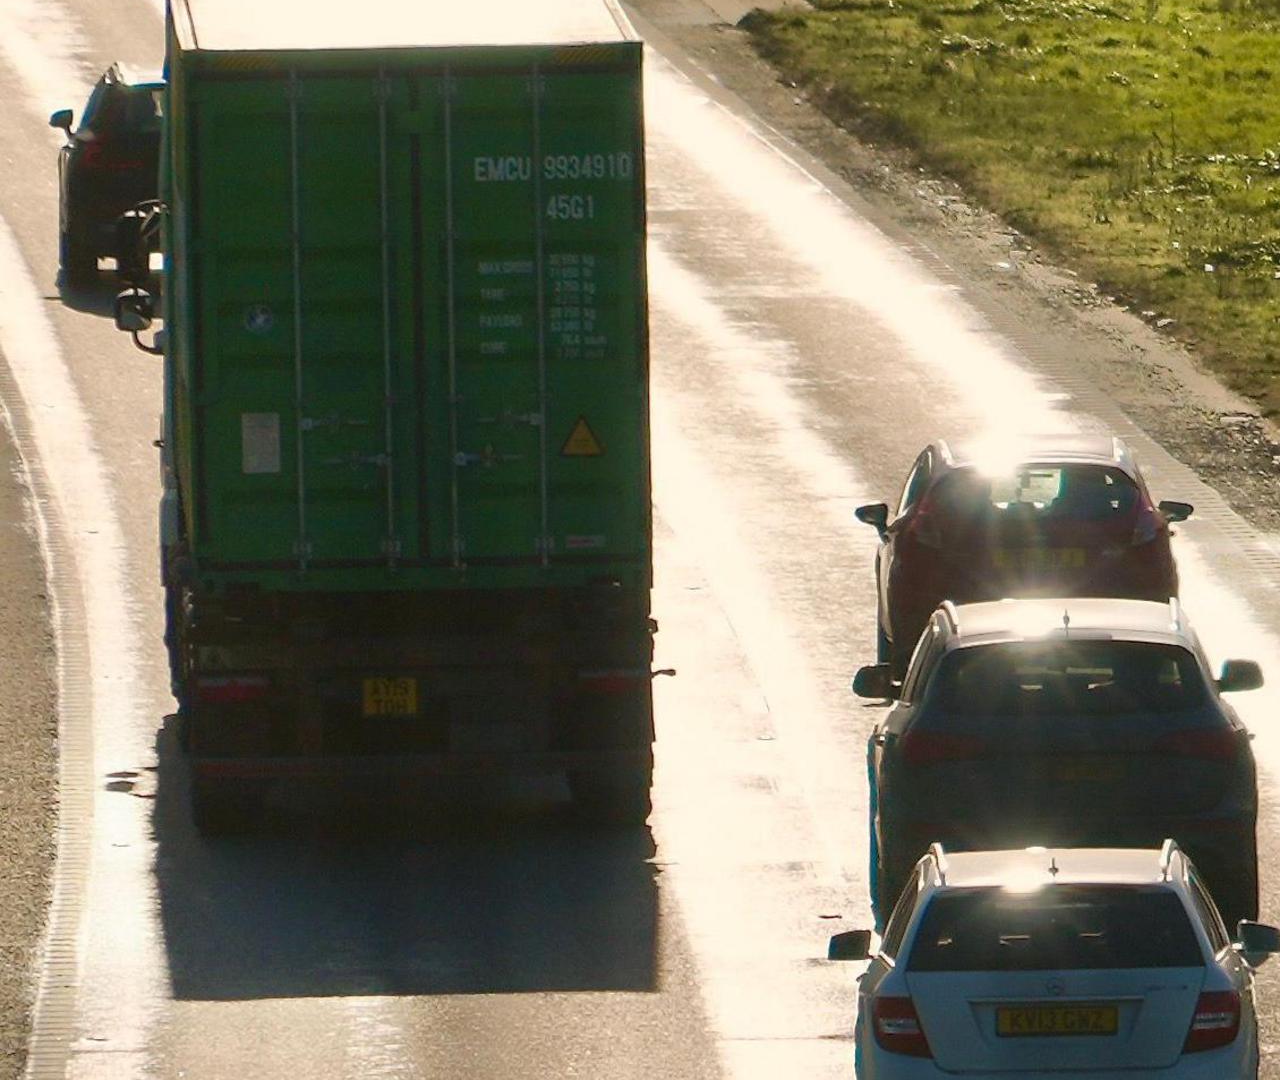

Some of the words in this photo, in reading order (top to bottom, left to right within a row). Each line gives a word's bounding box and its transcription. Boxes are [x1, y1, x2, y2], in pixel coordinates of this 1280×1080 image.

[474, 156, 531, 182] EMCU
[543, 152, 632, 181] 9934910
[547, 194, 594, 220] 45G1
